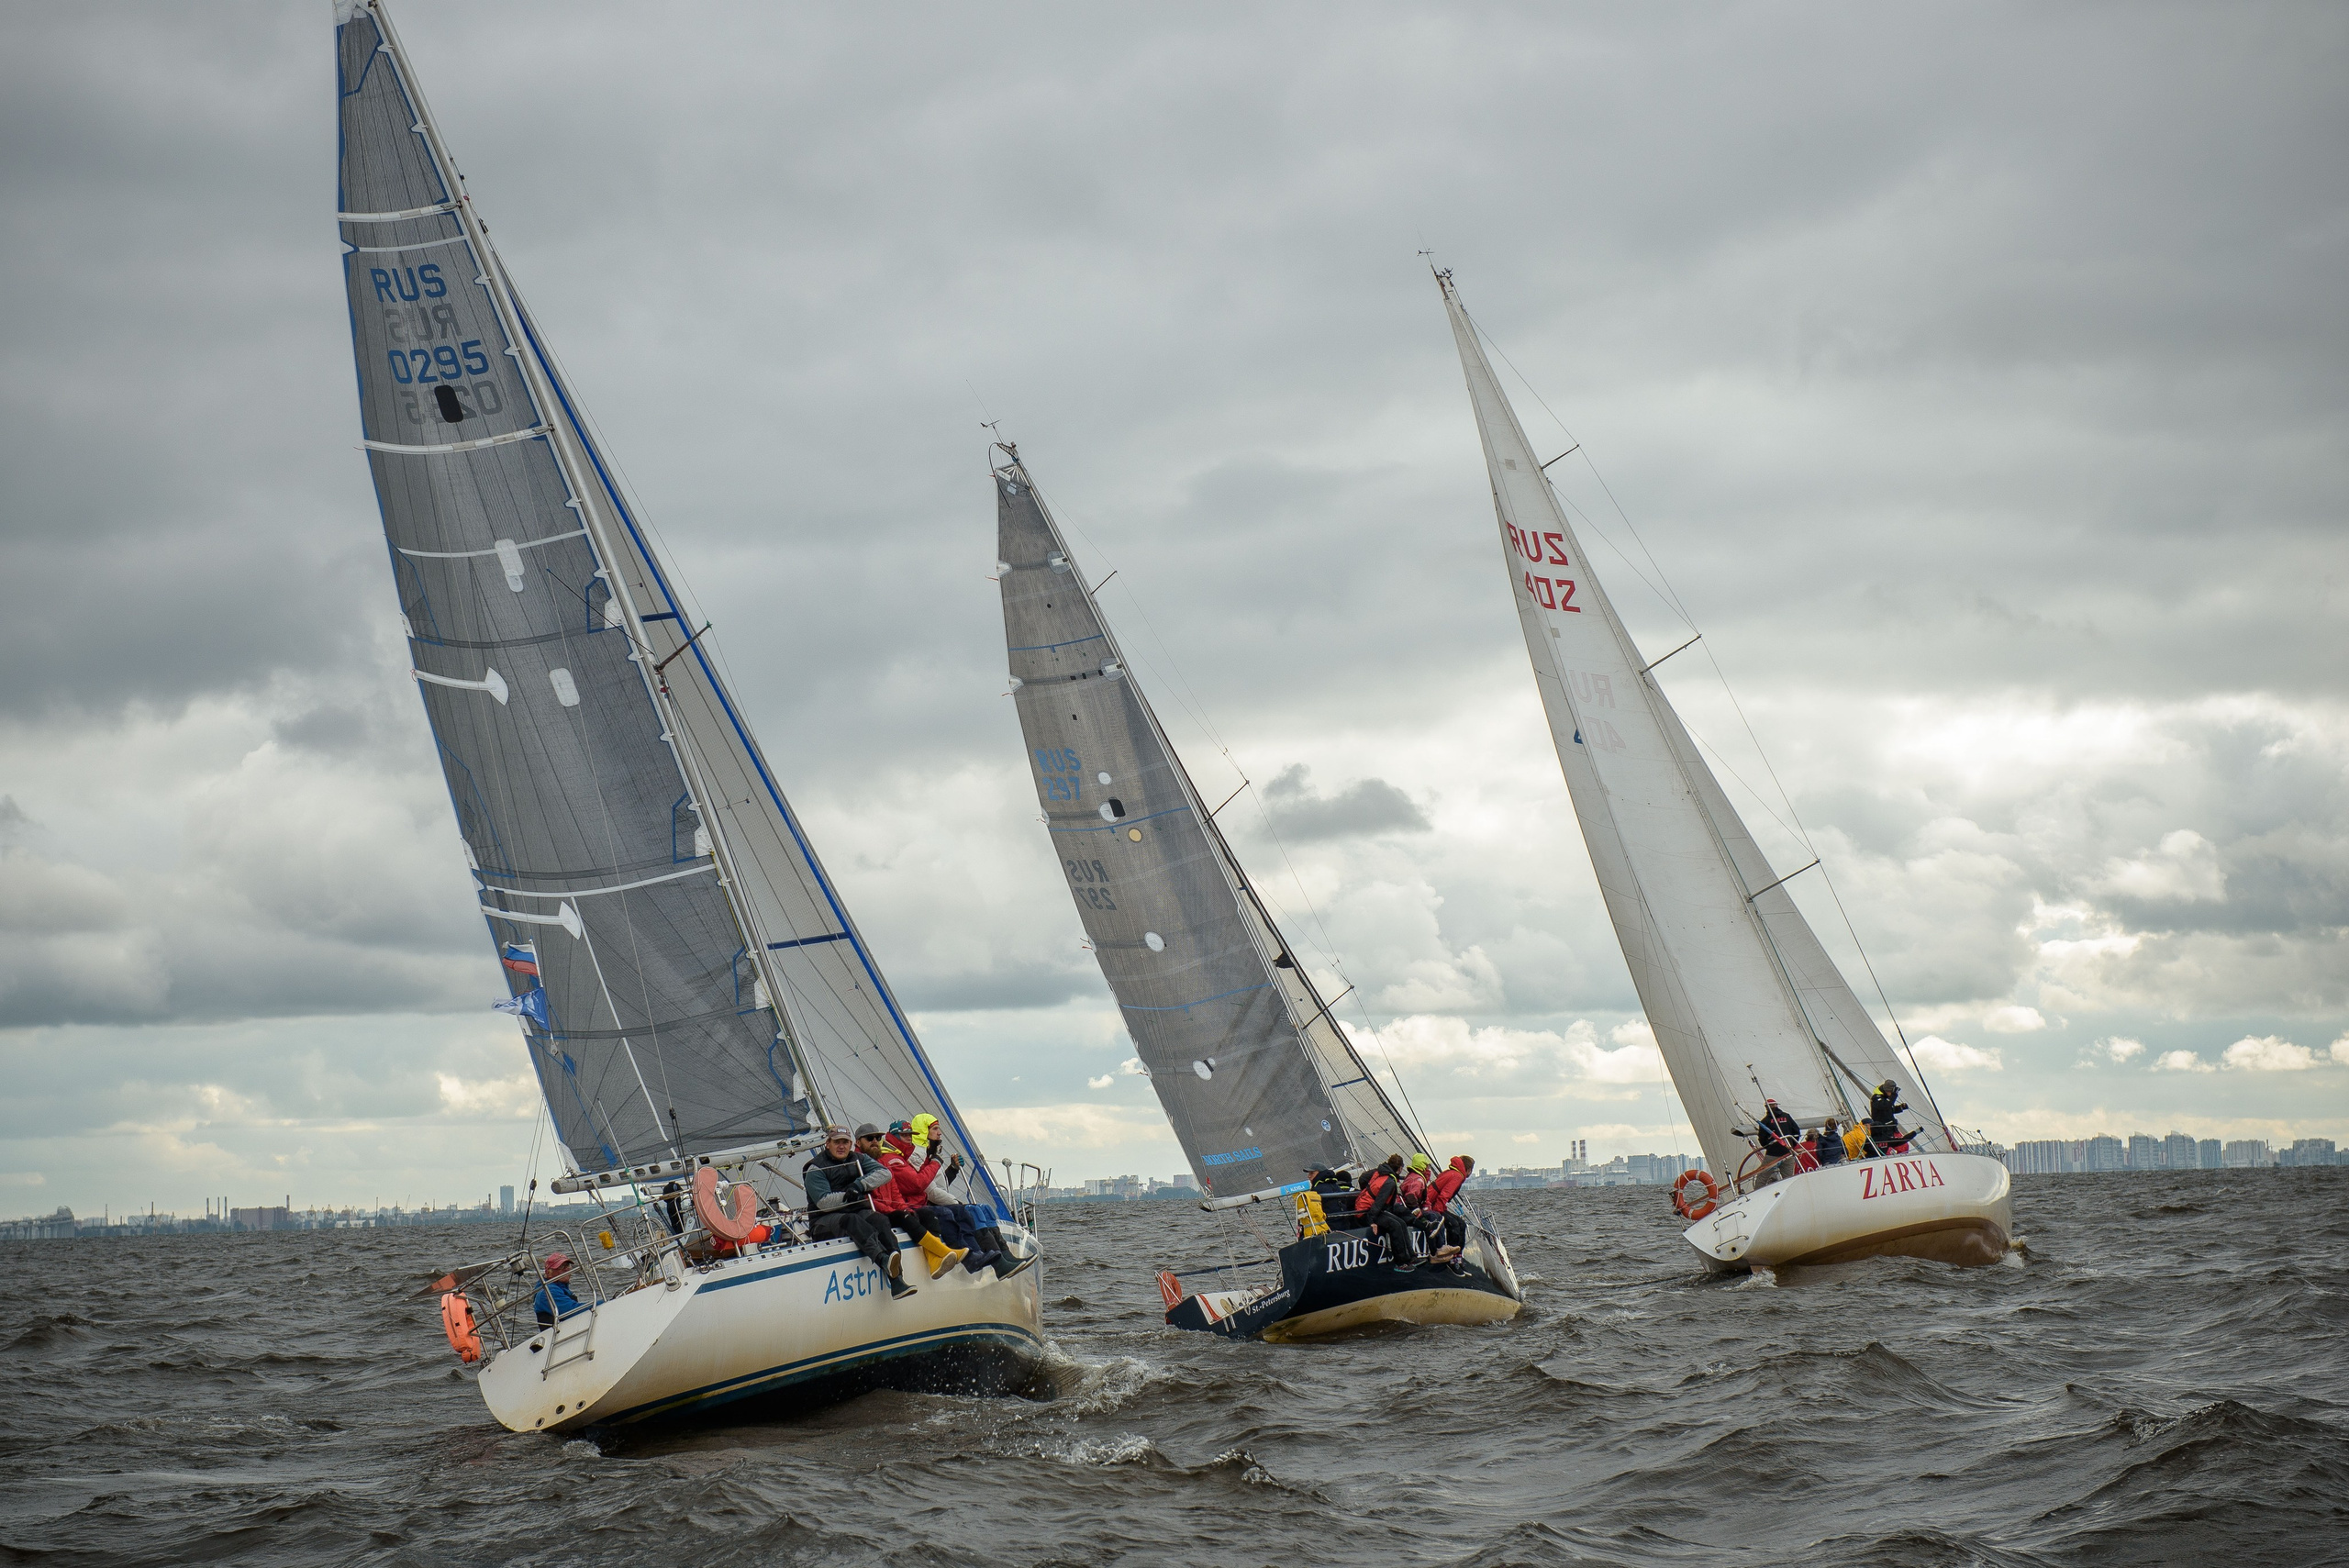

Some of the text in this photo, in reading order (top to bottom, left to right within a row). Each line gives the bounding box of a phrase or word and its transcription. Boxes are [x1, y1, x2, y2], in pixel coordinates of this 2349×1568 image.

[370, 263, 447, 303] RUS
[388, 339, 489, 384] 0295
[1505, 520, 1569, 566] RUS
[1525, 571, 1581, 613] 402
[1034, 748, 1081, 773] RUS
[1042, 776, 1081, 801] 297
[1201, 1146, 1263, 1166] NORTH SAILS
[1859, 1159, 1945, 1200] ZARYA
[1326, 1238, 1369, 1273] RUS
